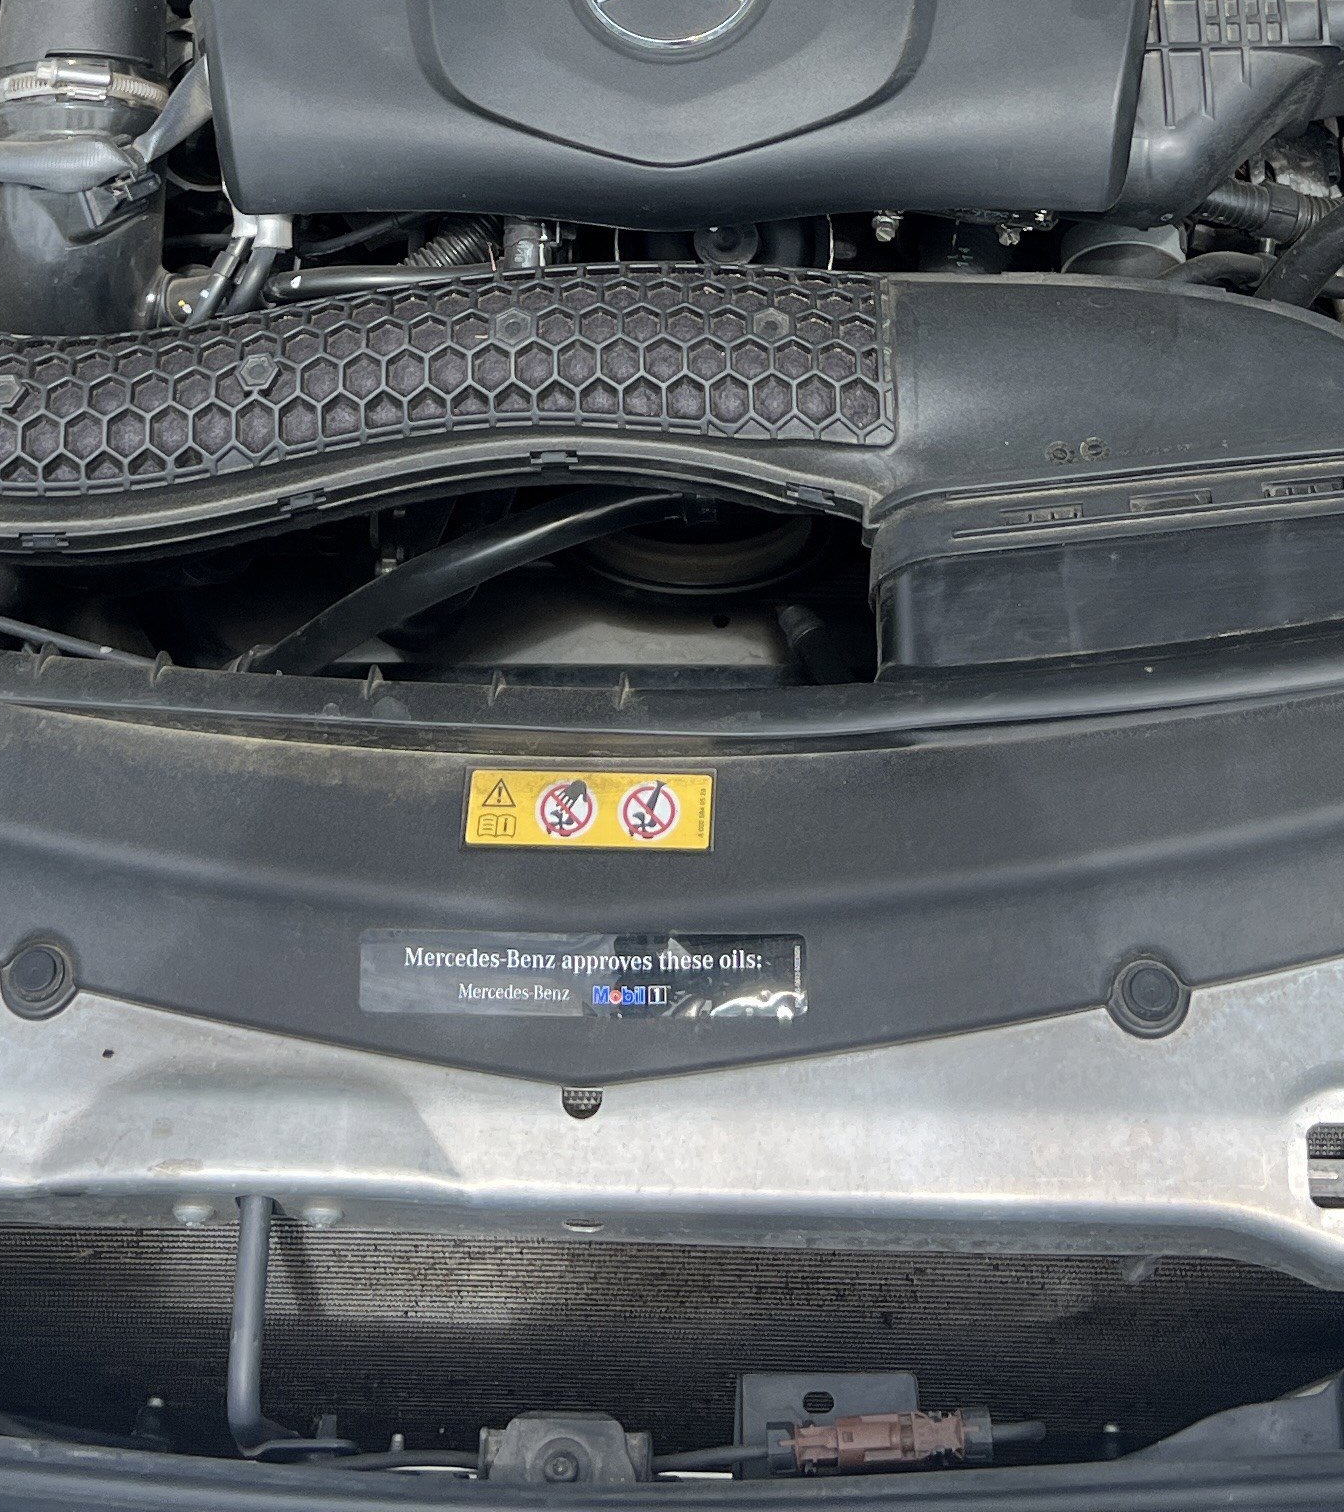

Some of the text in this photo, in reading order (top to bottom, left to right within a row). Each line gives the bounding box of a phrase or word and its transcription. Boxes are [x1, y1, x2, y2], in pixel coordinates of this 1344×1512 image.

[404, 947, 762, 975] Mercedes-Benz approves these oils:
[458, 982, 570, 1002] Mercedes-Benz
[592, 985, 646, 1005] Mobil
